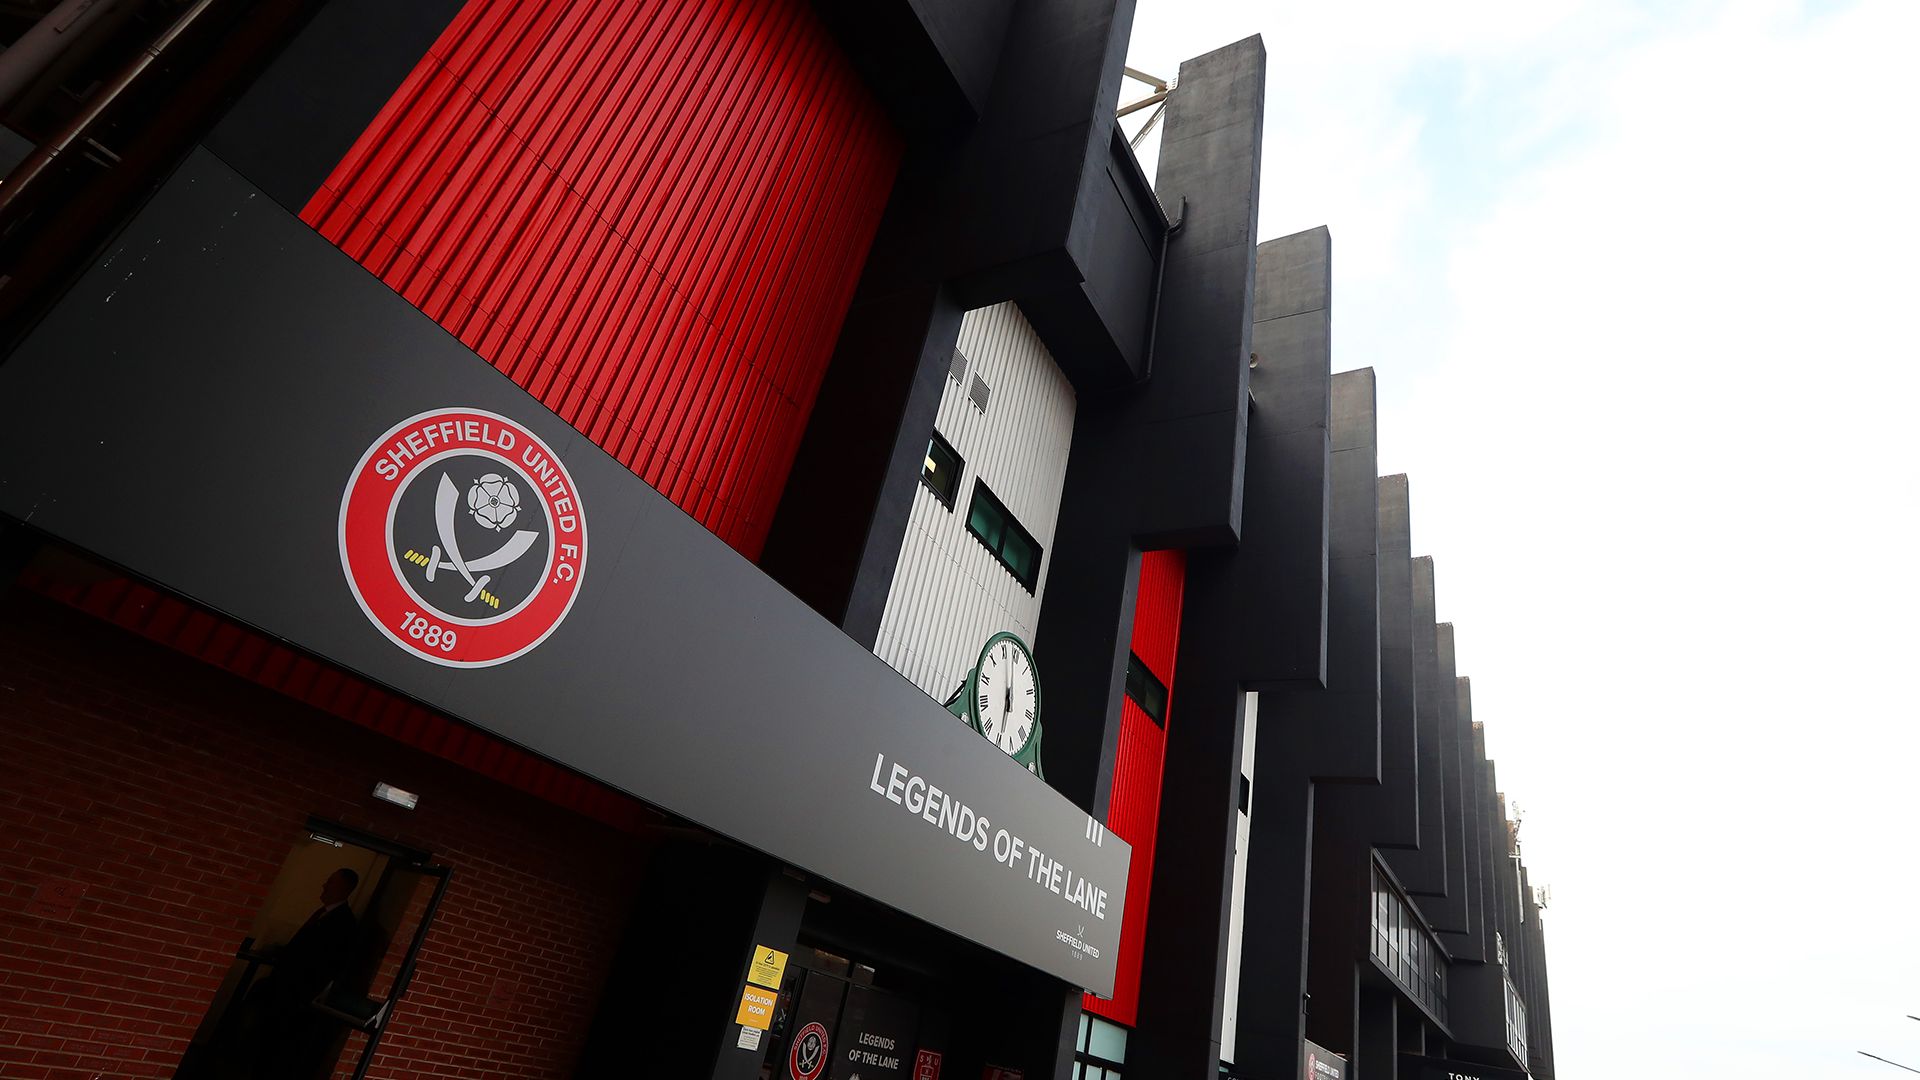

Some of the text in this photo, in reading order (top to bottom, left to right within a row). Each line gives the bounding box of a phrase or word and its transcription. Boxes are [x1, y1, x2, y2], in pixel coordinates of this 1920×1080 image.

[375, 421, 578, 584] SHEFFIELD UNITED F.C.
[400, 611, 457, 652] 1889
[870, 753, 1108, 920] LEGENDS OF THE LANE
[1056, 930, 1100, 959] SHEFFIELD UNITED
[744, 993, 773, 1006] ISOLATION
[748, 1005, 766, 1016] ROOM
[859, 1032, 896, 1050] LEGENDS
[848, 1049, 899, 1070] OF THE LANE
